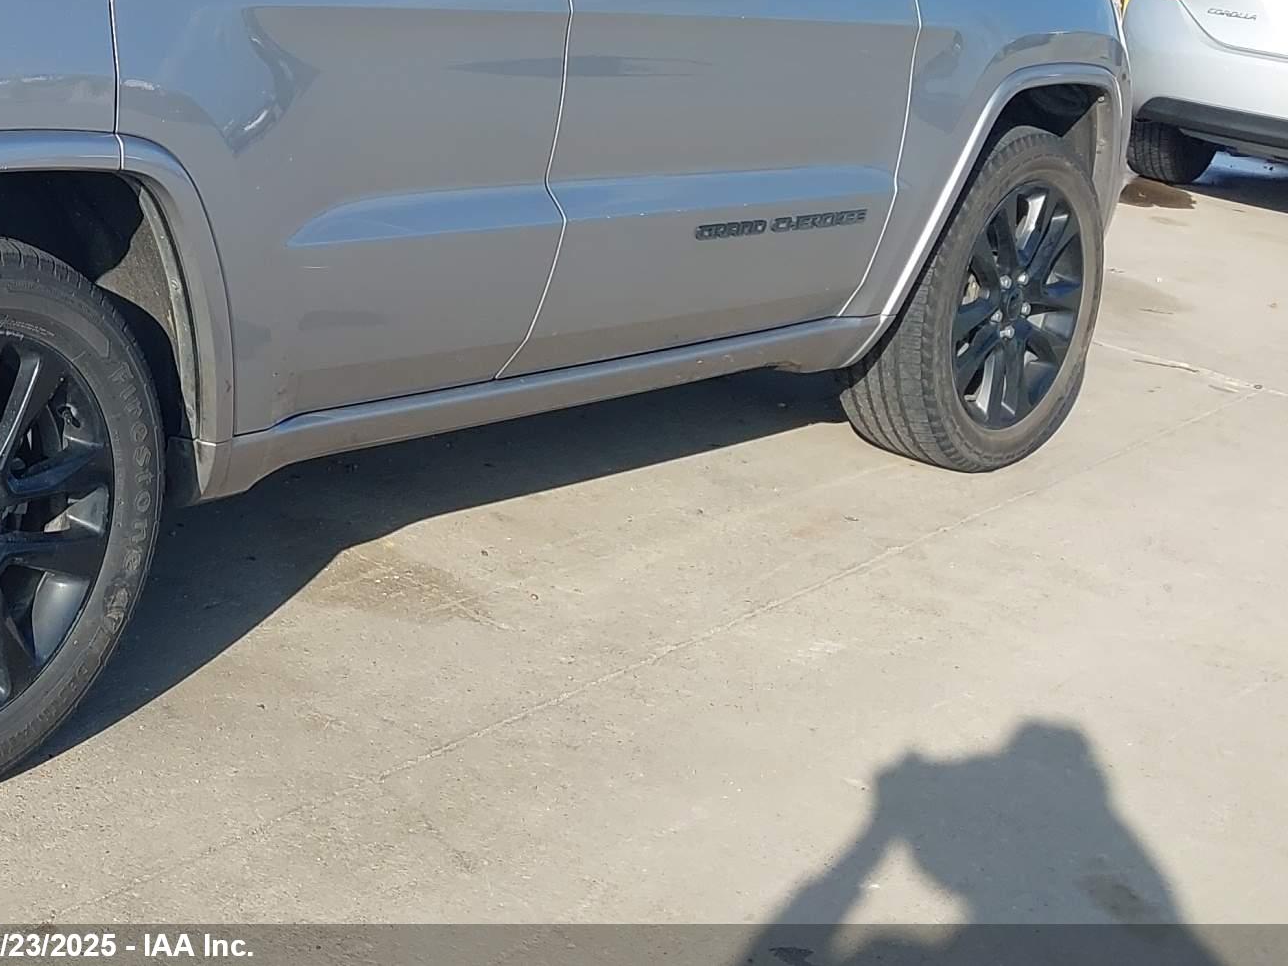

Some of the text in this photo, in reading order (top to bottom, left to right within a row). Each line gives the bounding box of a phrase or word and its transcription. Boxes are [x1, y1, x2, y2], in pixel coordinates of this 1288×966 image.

[1207, 7, 1257, 20] COROLLA
[695, 208, 868, 241] GRAND CHEROKEE
[110, 360, 154, 572] Firestone
